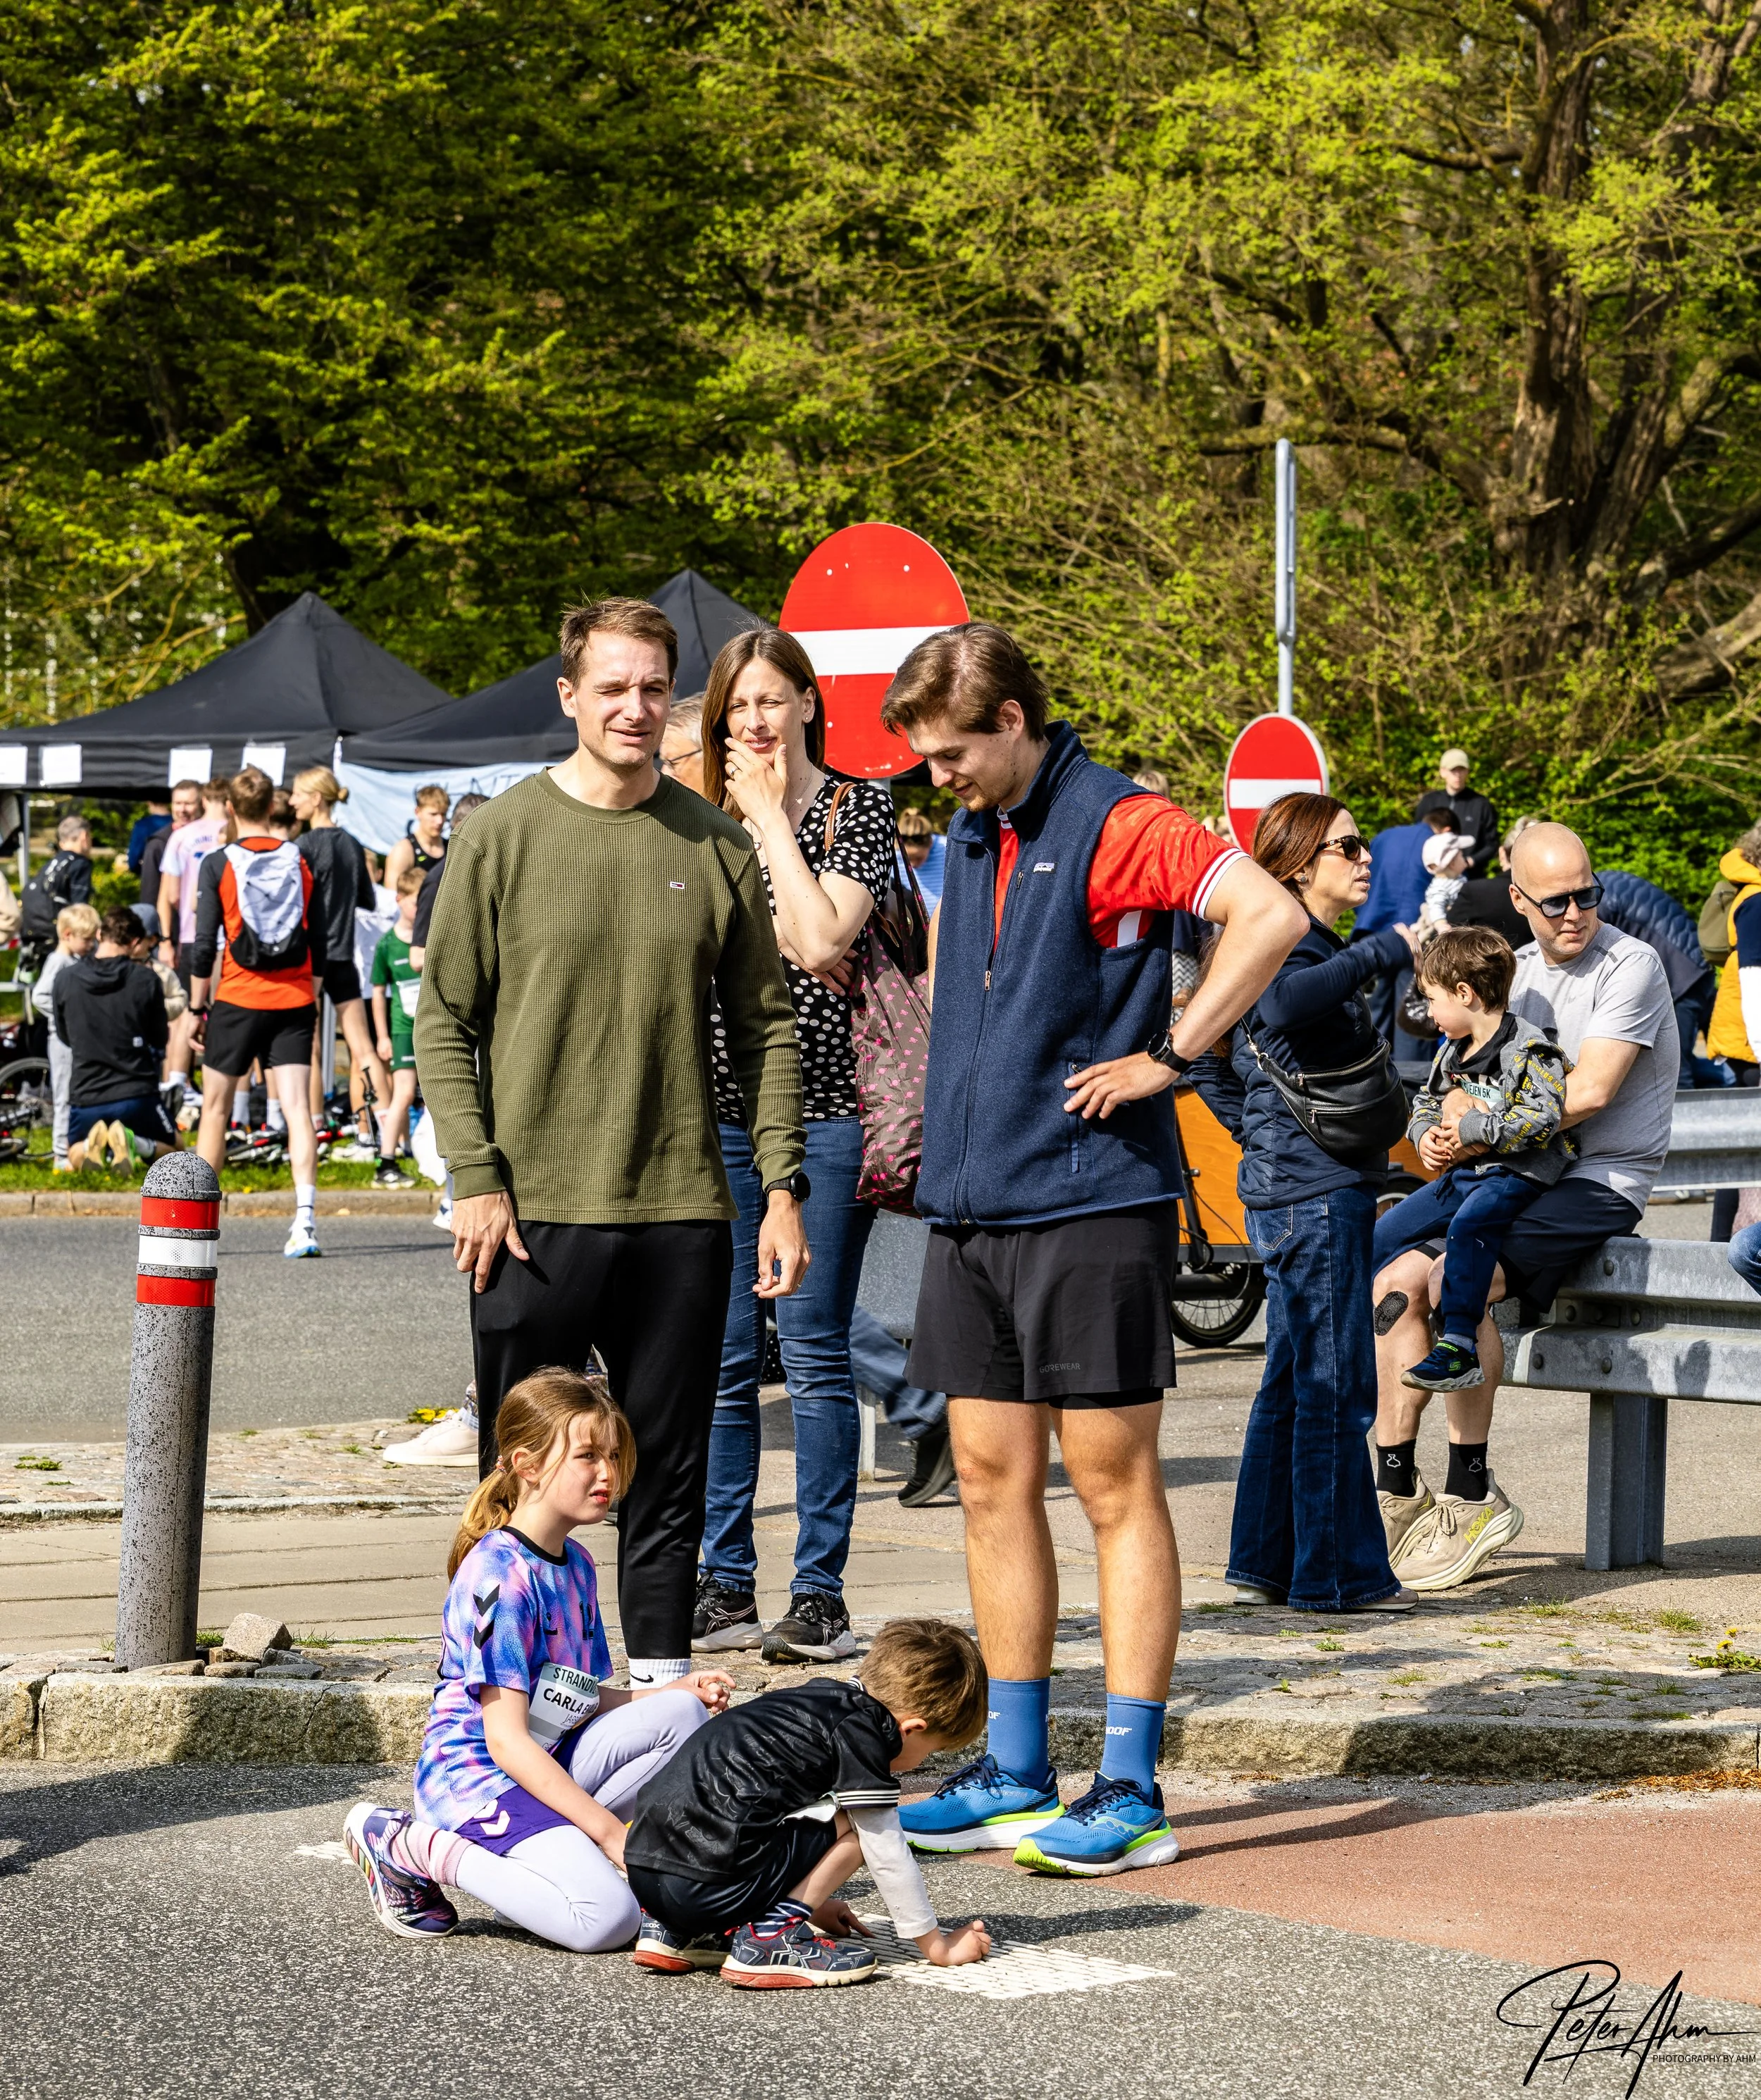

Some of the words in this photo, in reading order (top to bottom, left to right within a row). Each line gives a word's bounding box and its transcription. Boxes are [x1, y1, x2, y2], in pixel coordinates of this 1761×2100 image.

[1482, 1088, 1491, 1099] 5K
[1464, 1506, 1494, 1545] HOKA
[543, 1687, 584, 1715] CARLA
